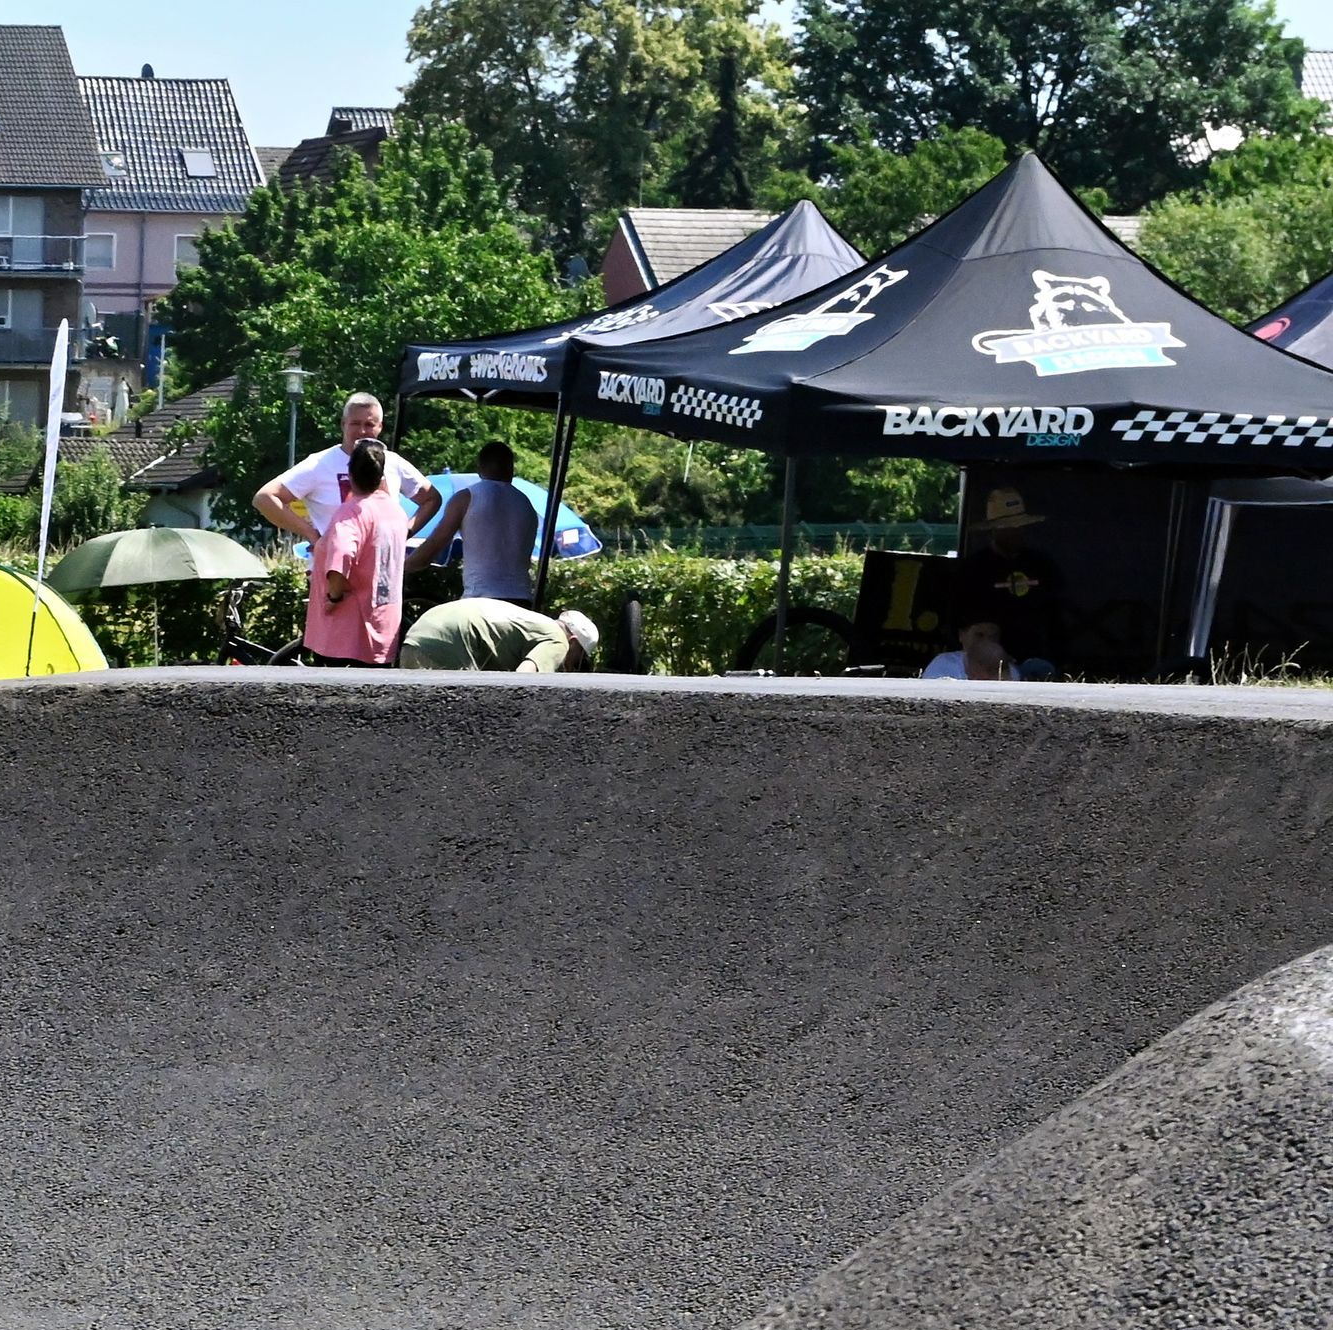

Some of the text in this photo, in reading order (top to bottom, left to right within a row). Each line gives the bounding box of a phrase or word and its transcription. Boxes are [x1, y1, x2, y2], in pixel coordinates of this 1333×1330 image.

[597, 370, 666, 406] BACKYARD
[879, 405, 1095, 438] BACKYARD
[1027, 432, 1082, 447] DESIGN
